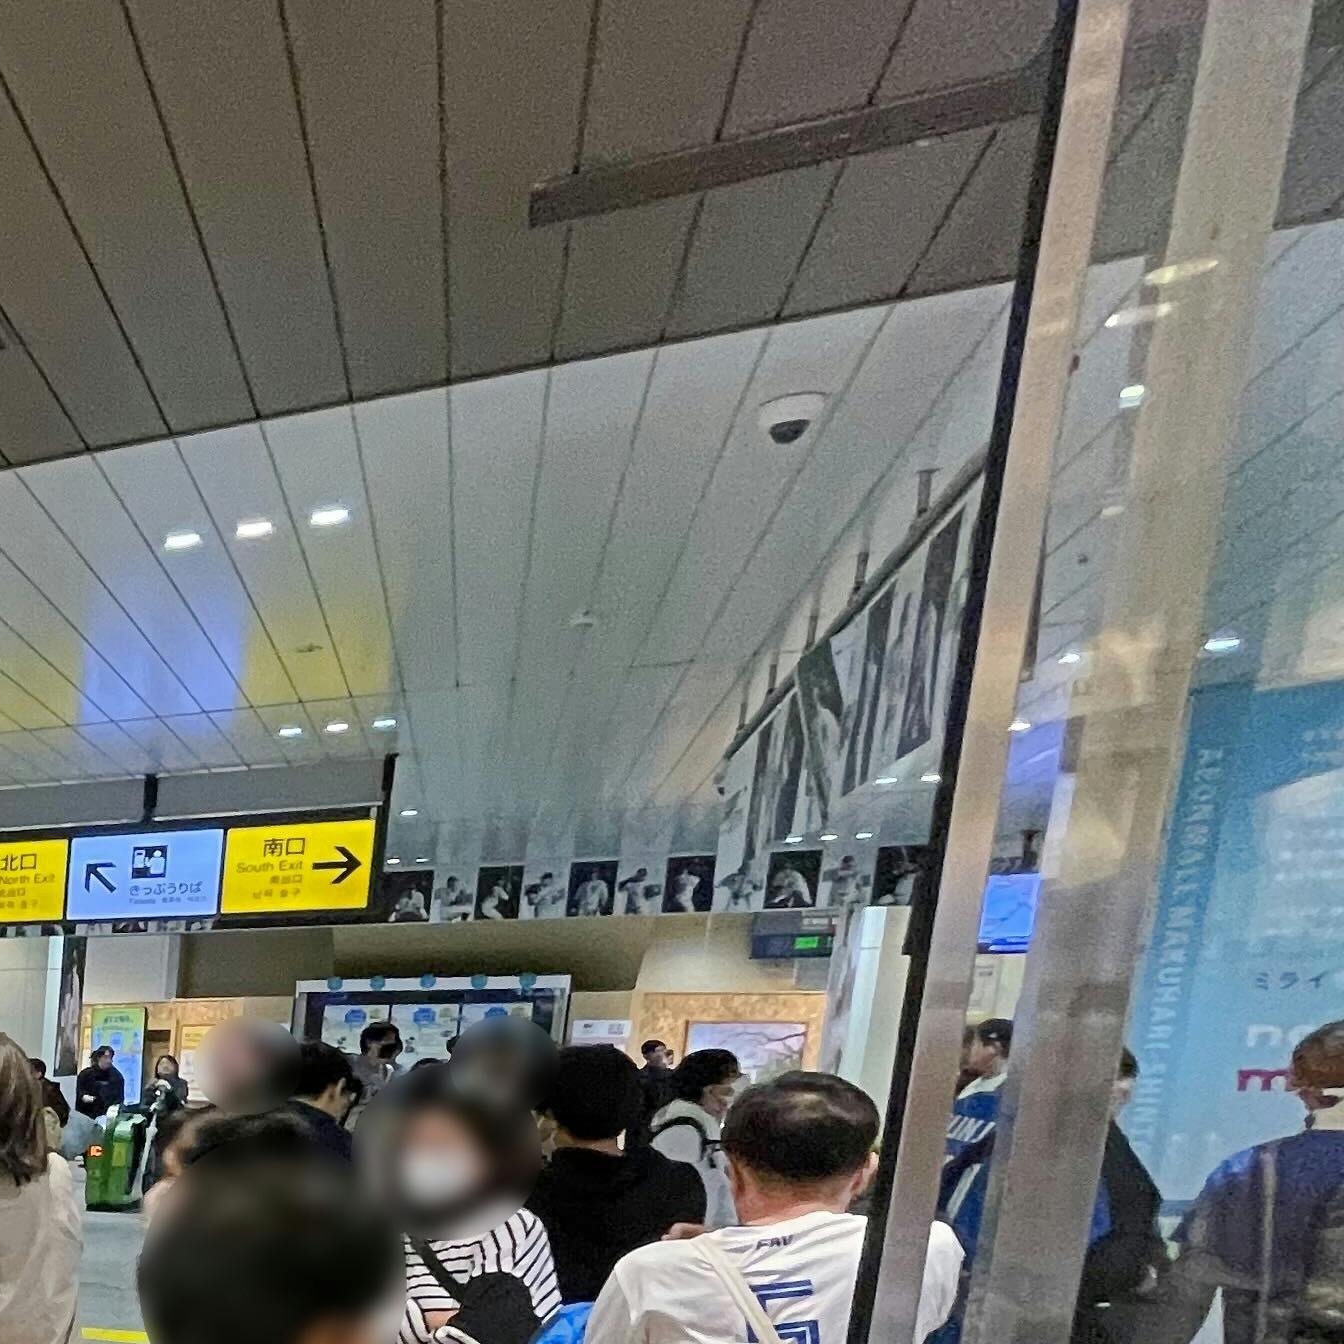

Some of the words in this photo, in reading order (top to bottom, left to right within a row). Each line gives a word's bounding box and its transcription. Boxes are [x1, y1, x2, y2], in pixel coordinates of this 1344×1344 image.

[263, 837, 305, 857] 南口
[0, 853, 37, 871] 北口
[236, 860, 273, 873] South
[279, 859, 303, 871] Exit
[34, 872, 55, 884] Exit
[129, 880, 203, 897] きっぷうりば
